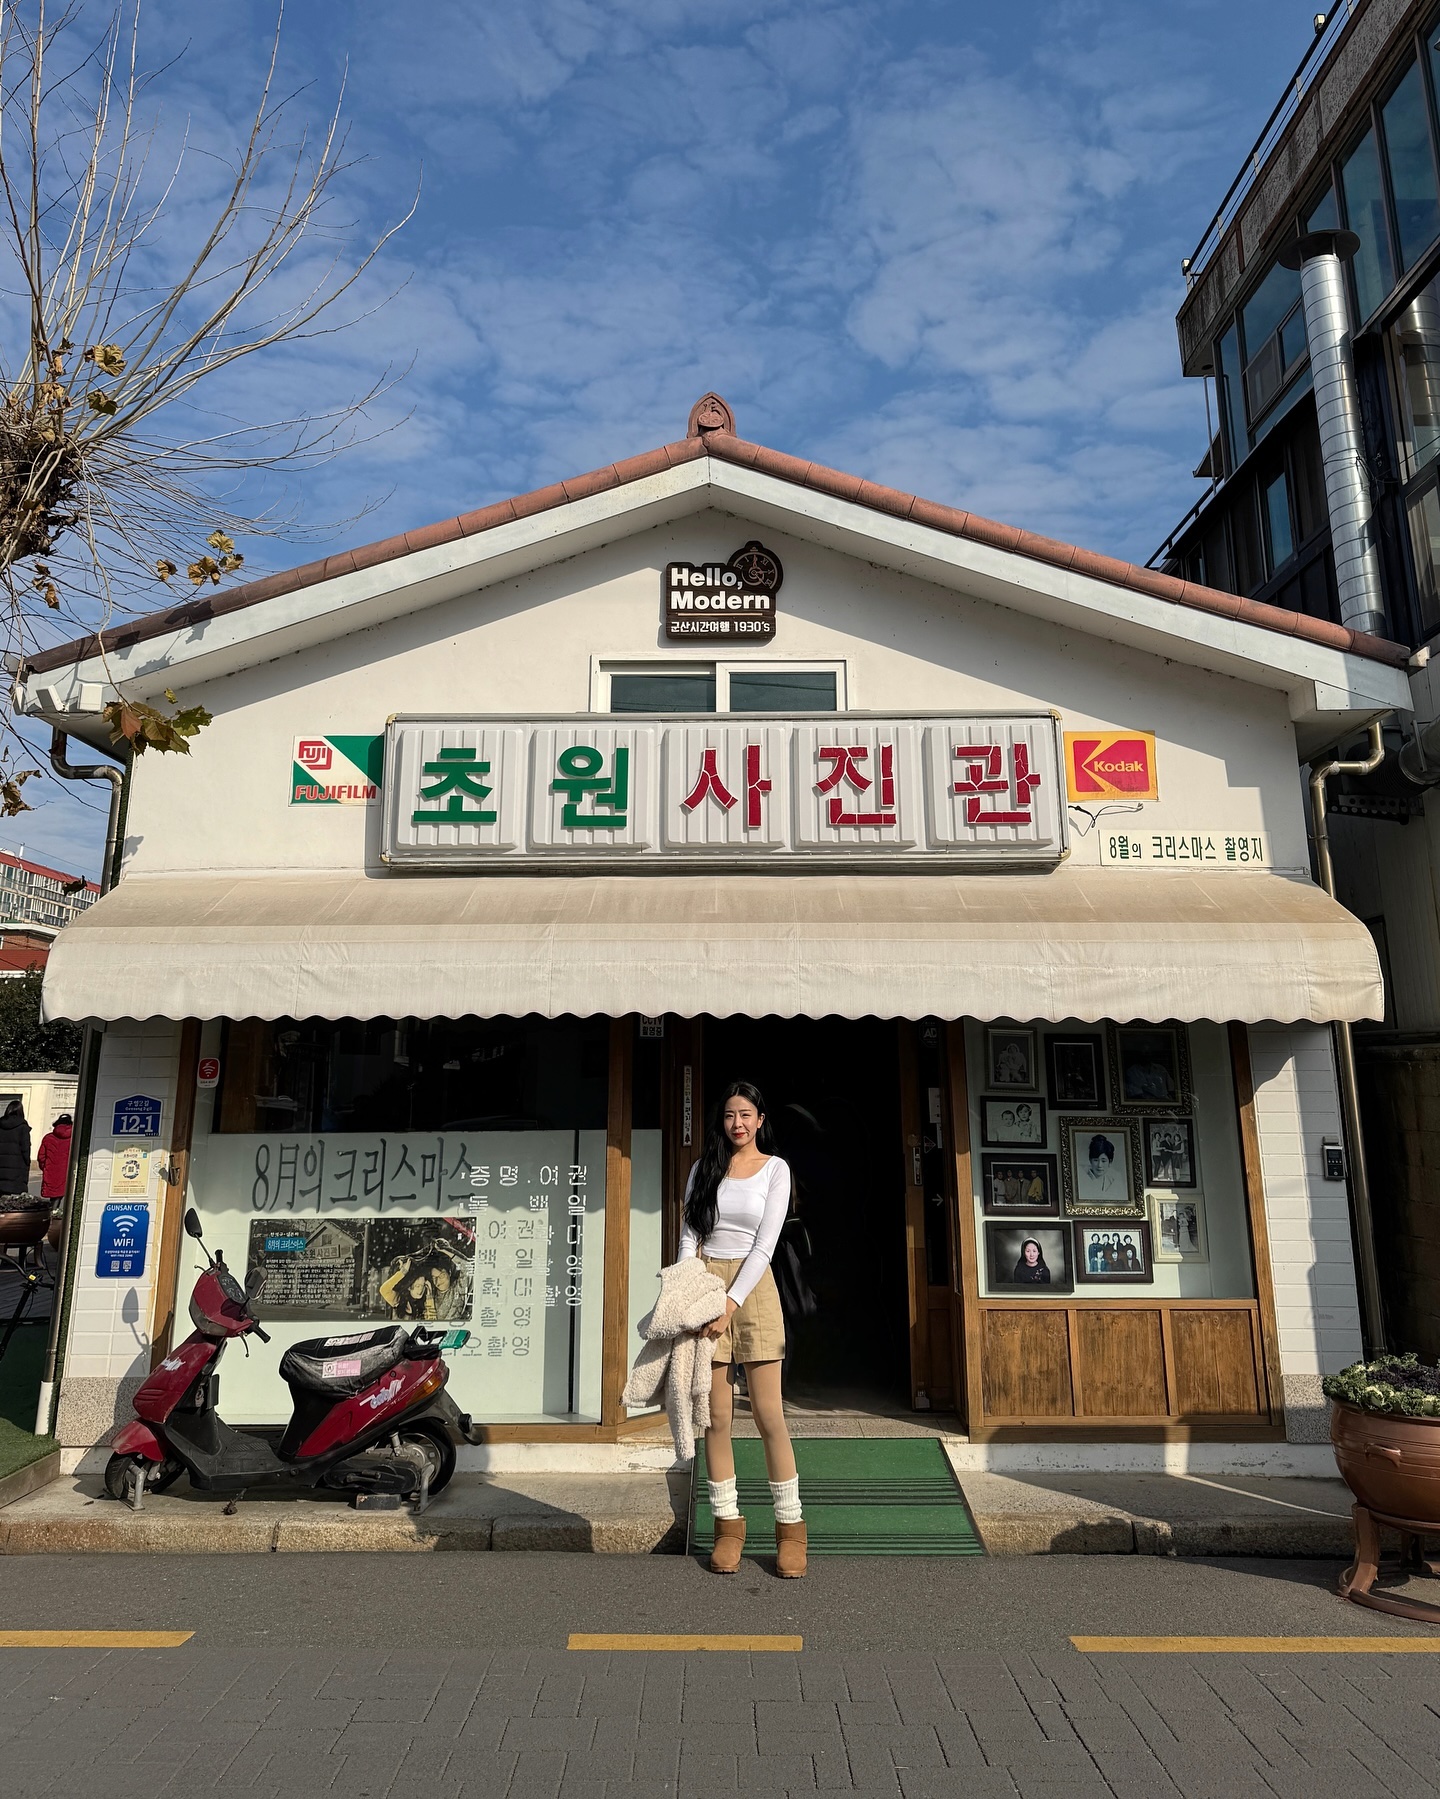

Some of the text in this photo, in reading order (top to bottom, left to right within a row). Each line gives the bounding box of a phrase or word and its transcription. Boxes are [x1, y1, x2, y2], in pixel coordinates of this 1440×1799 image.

[670, 567, 744, 590] Hello,
[670, 590, 770, 610] Modern
[670, 621, 730, 633] 군산시간여행
[1093, 760, 1144, 773] Kodak
[295, 784, 377, 801] FUJIFILM
[1109, 835, 1264, 862] 8월의 크리스마스 촬영지
[120, 1115, 154, 1133] 12-1
[106, 1204, 147, 1212] GUNSAN CITY
